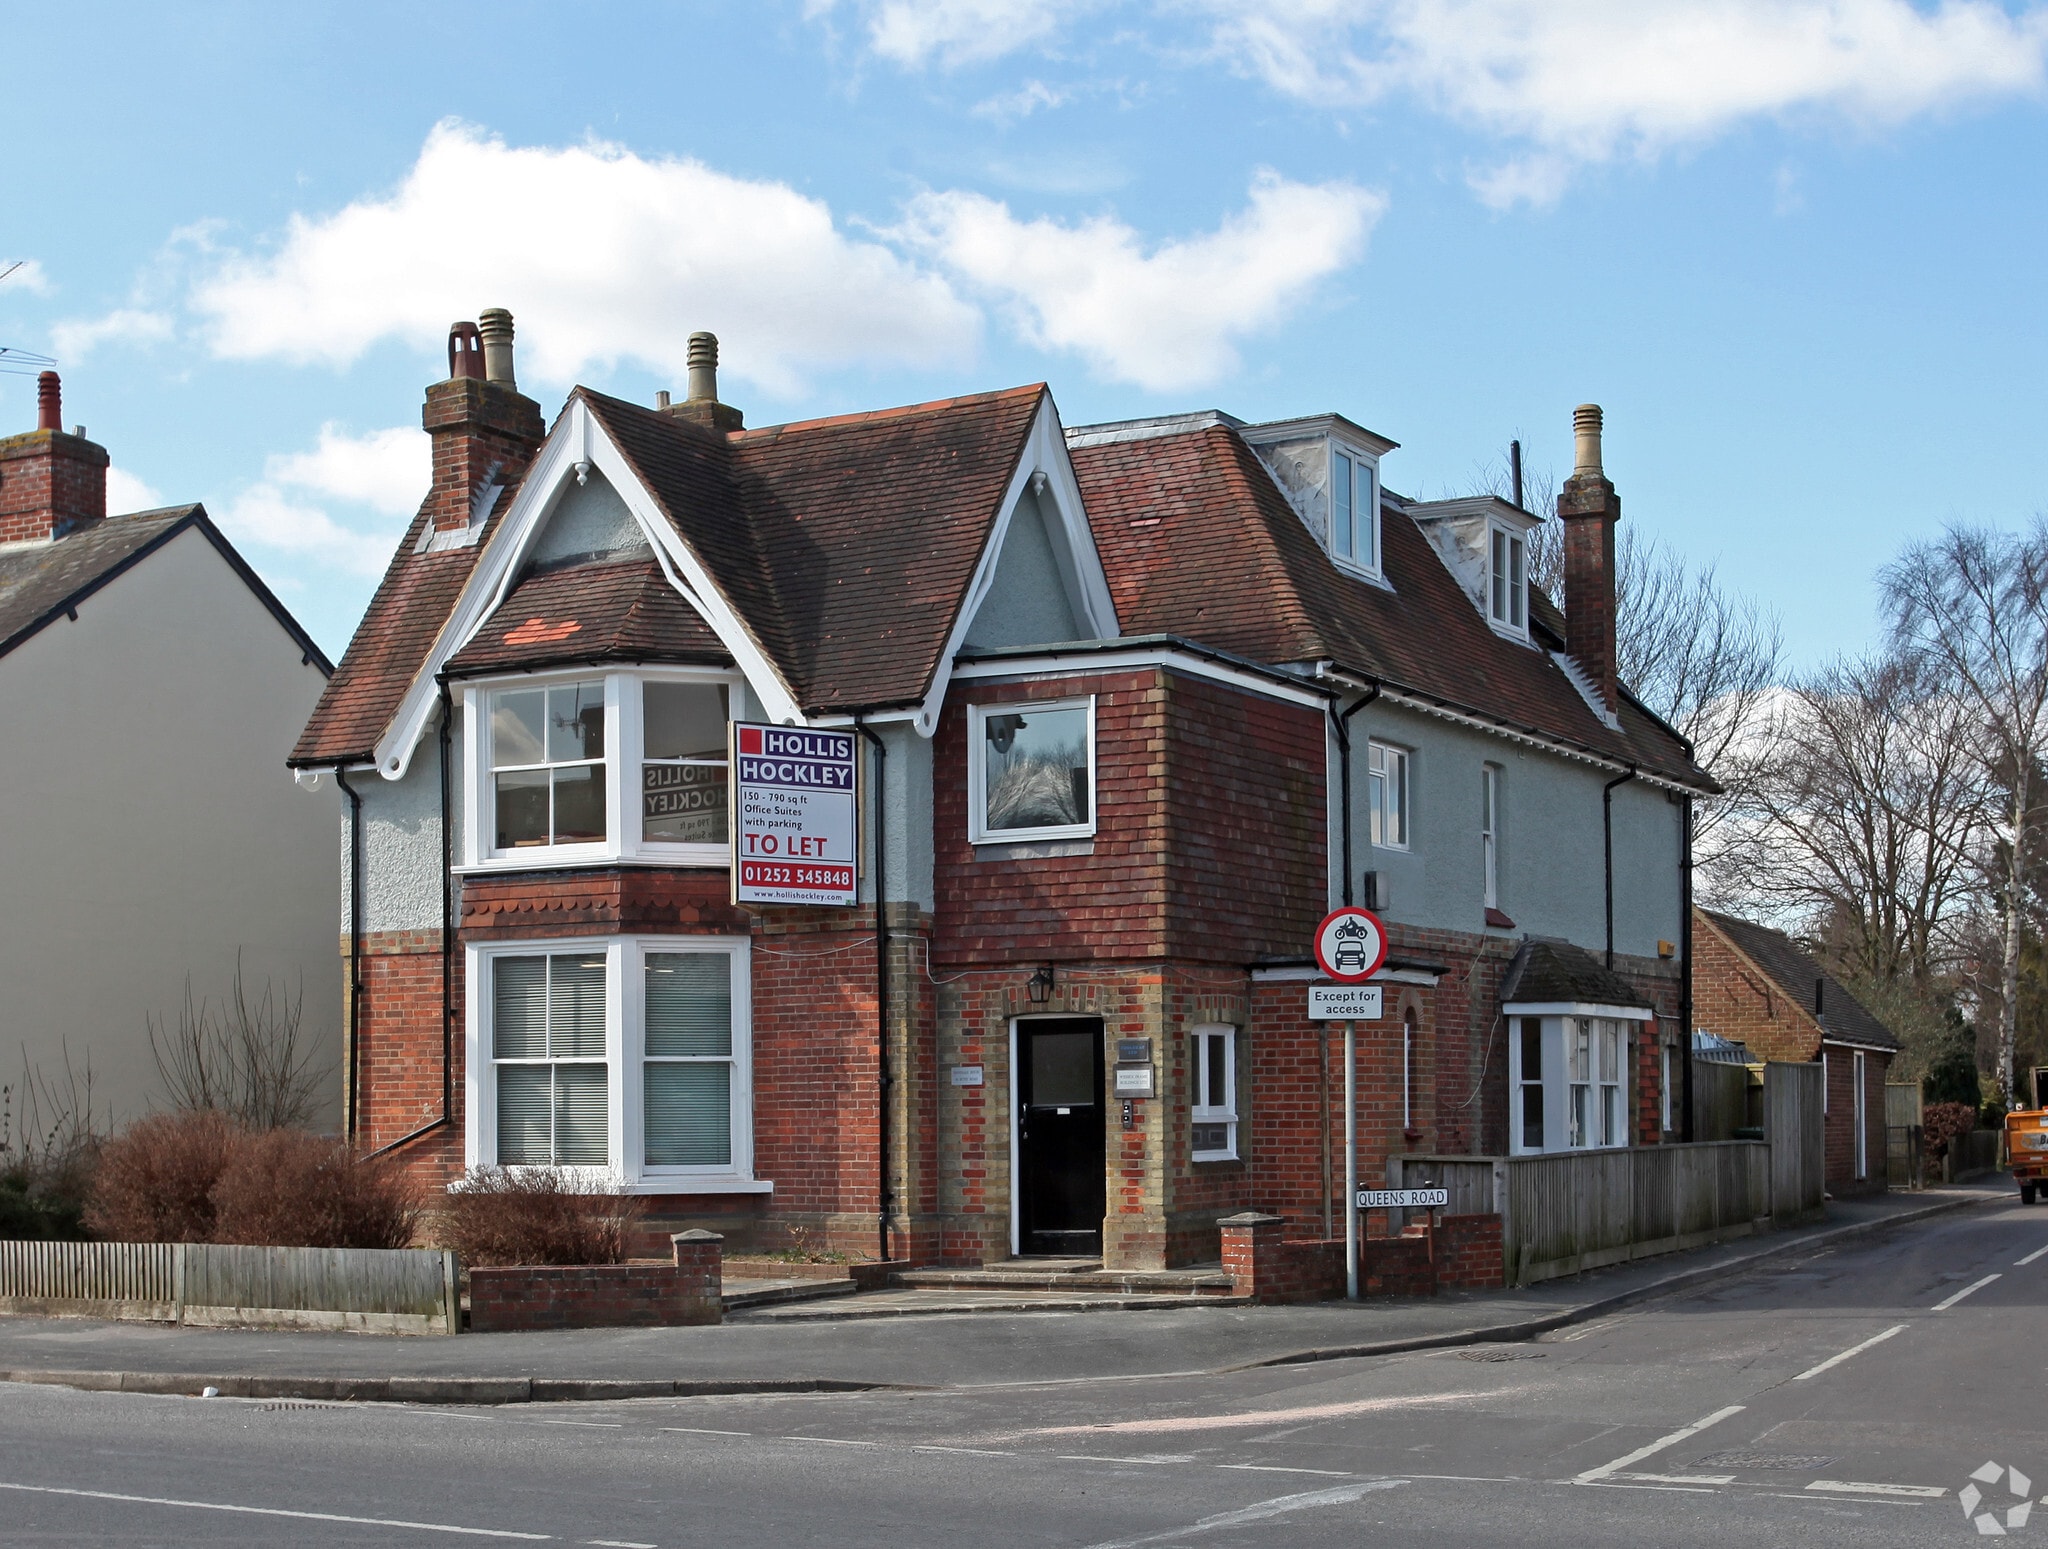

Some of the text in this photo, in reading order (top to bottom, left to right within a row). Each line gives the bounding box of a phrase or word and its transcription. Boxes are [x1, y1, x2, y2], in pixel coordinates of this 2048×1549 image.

[768, 733, 849, 758] HOLLIS
[742, 760, 849, 785] HOCKLEY
[744, 791, 759, 800] 150
[768, 793, 785, 802] 790
[787, 796, 798, 805] sq
[800, 795, 808, 804] ft
[744, 804, 802, 816] Office Suites
[745, 817, 803, 831] with parking
[745, 833, 828, 856] TO LET
[745, 866, 850, 886] 01252 545848
[754, 890, 843, 902] www.hollishockley.com
[1315, 991, 1375, 1002] Except for
[1326, 1006, 1365, 1014] access
[1358, 1191, 1444, 1206] QUEENS ROAD
